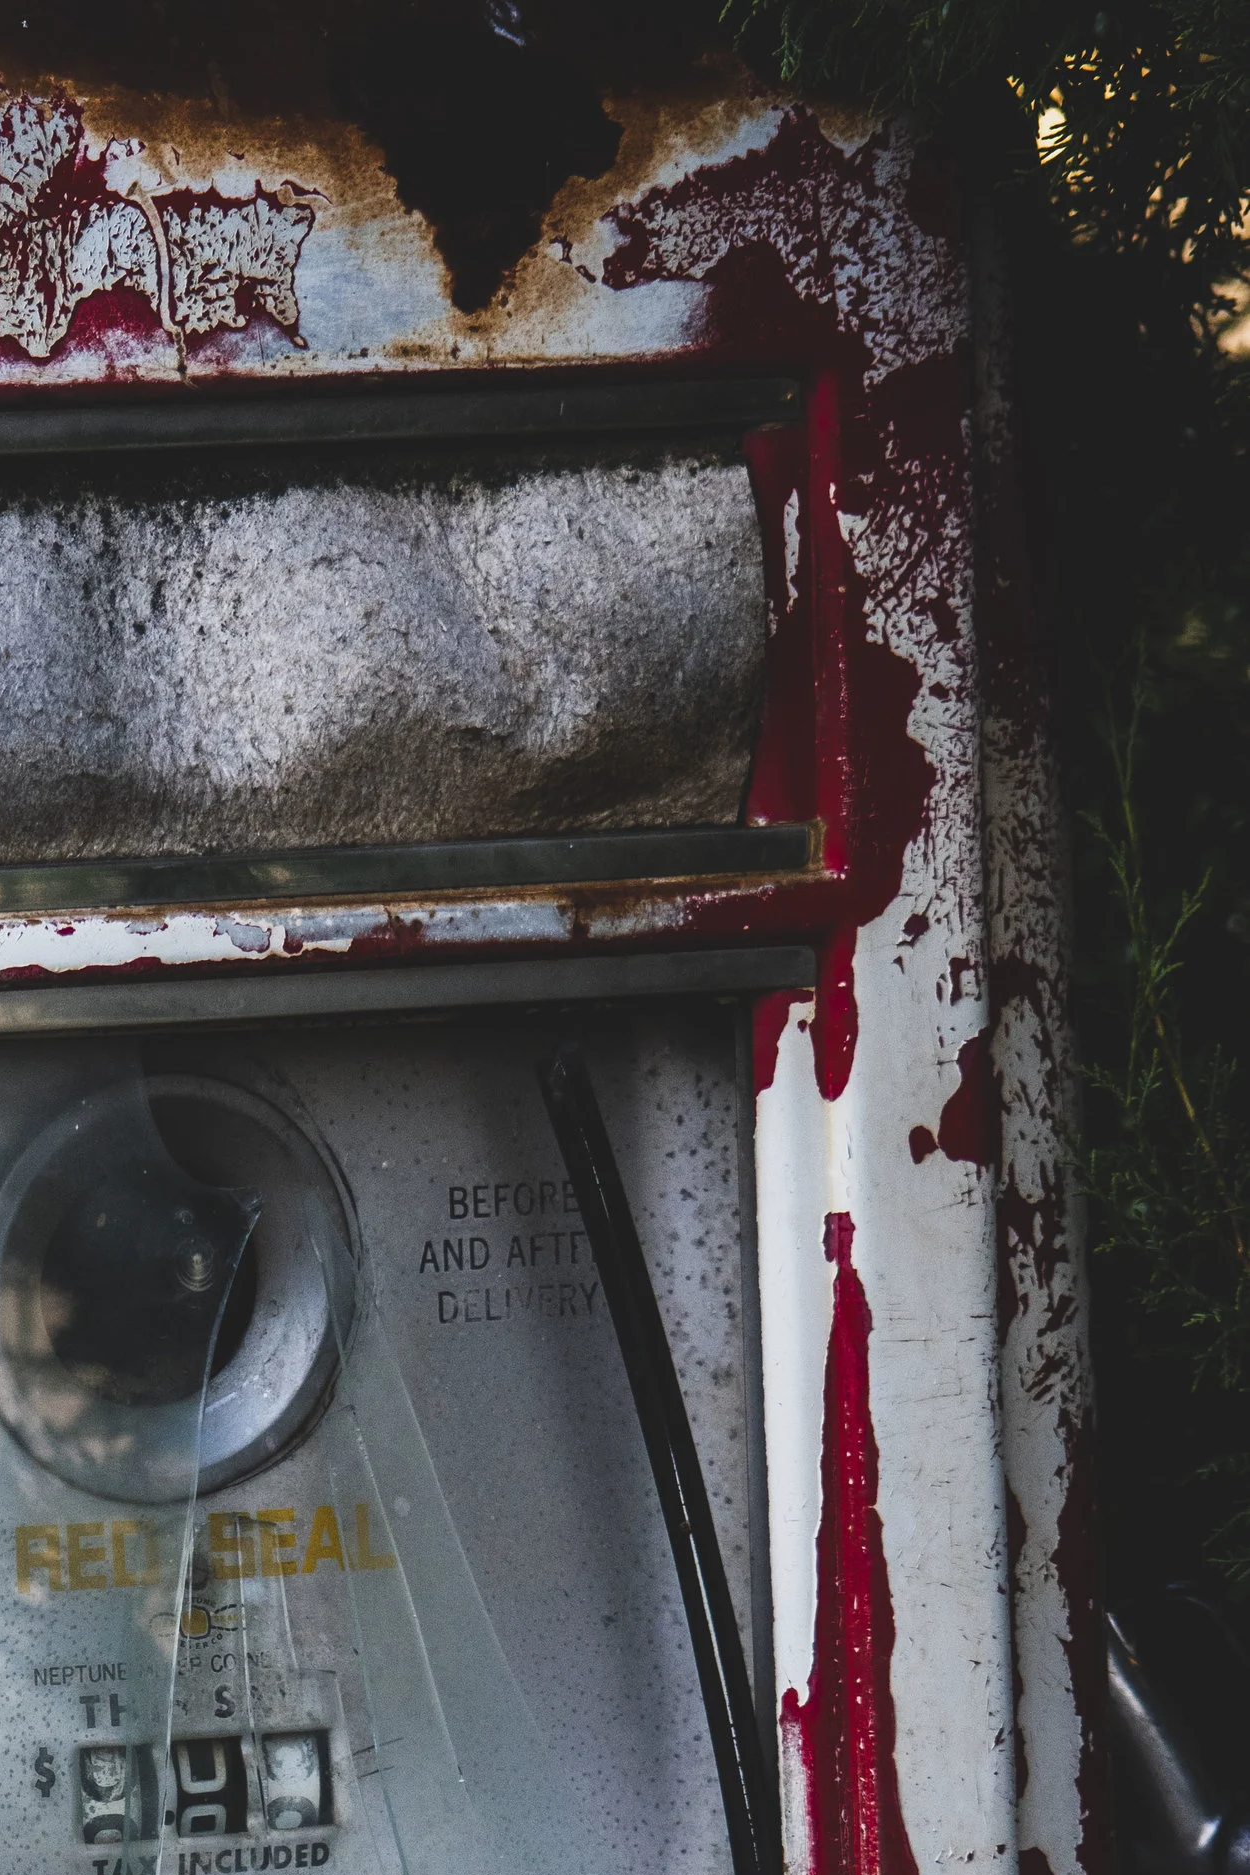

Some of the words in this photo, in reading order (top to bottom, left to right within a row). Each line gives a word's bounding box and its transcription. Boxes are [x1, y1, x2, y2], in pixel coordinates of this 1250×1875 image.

[448, 1180, 581, 1220] BEFORE
[419, 1236, 491, 1274] AND
[507, 1230, 595, 1268] AFTE
[437, 1282, 599, 1325] DELIVERY
[15, 1520, 161, 1593] RED
[208, 1503, 398, 1580] SEAL
[33, 1662, 127, 1687] NEPTUNE
[35, 1747, 56, 1798] $
